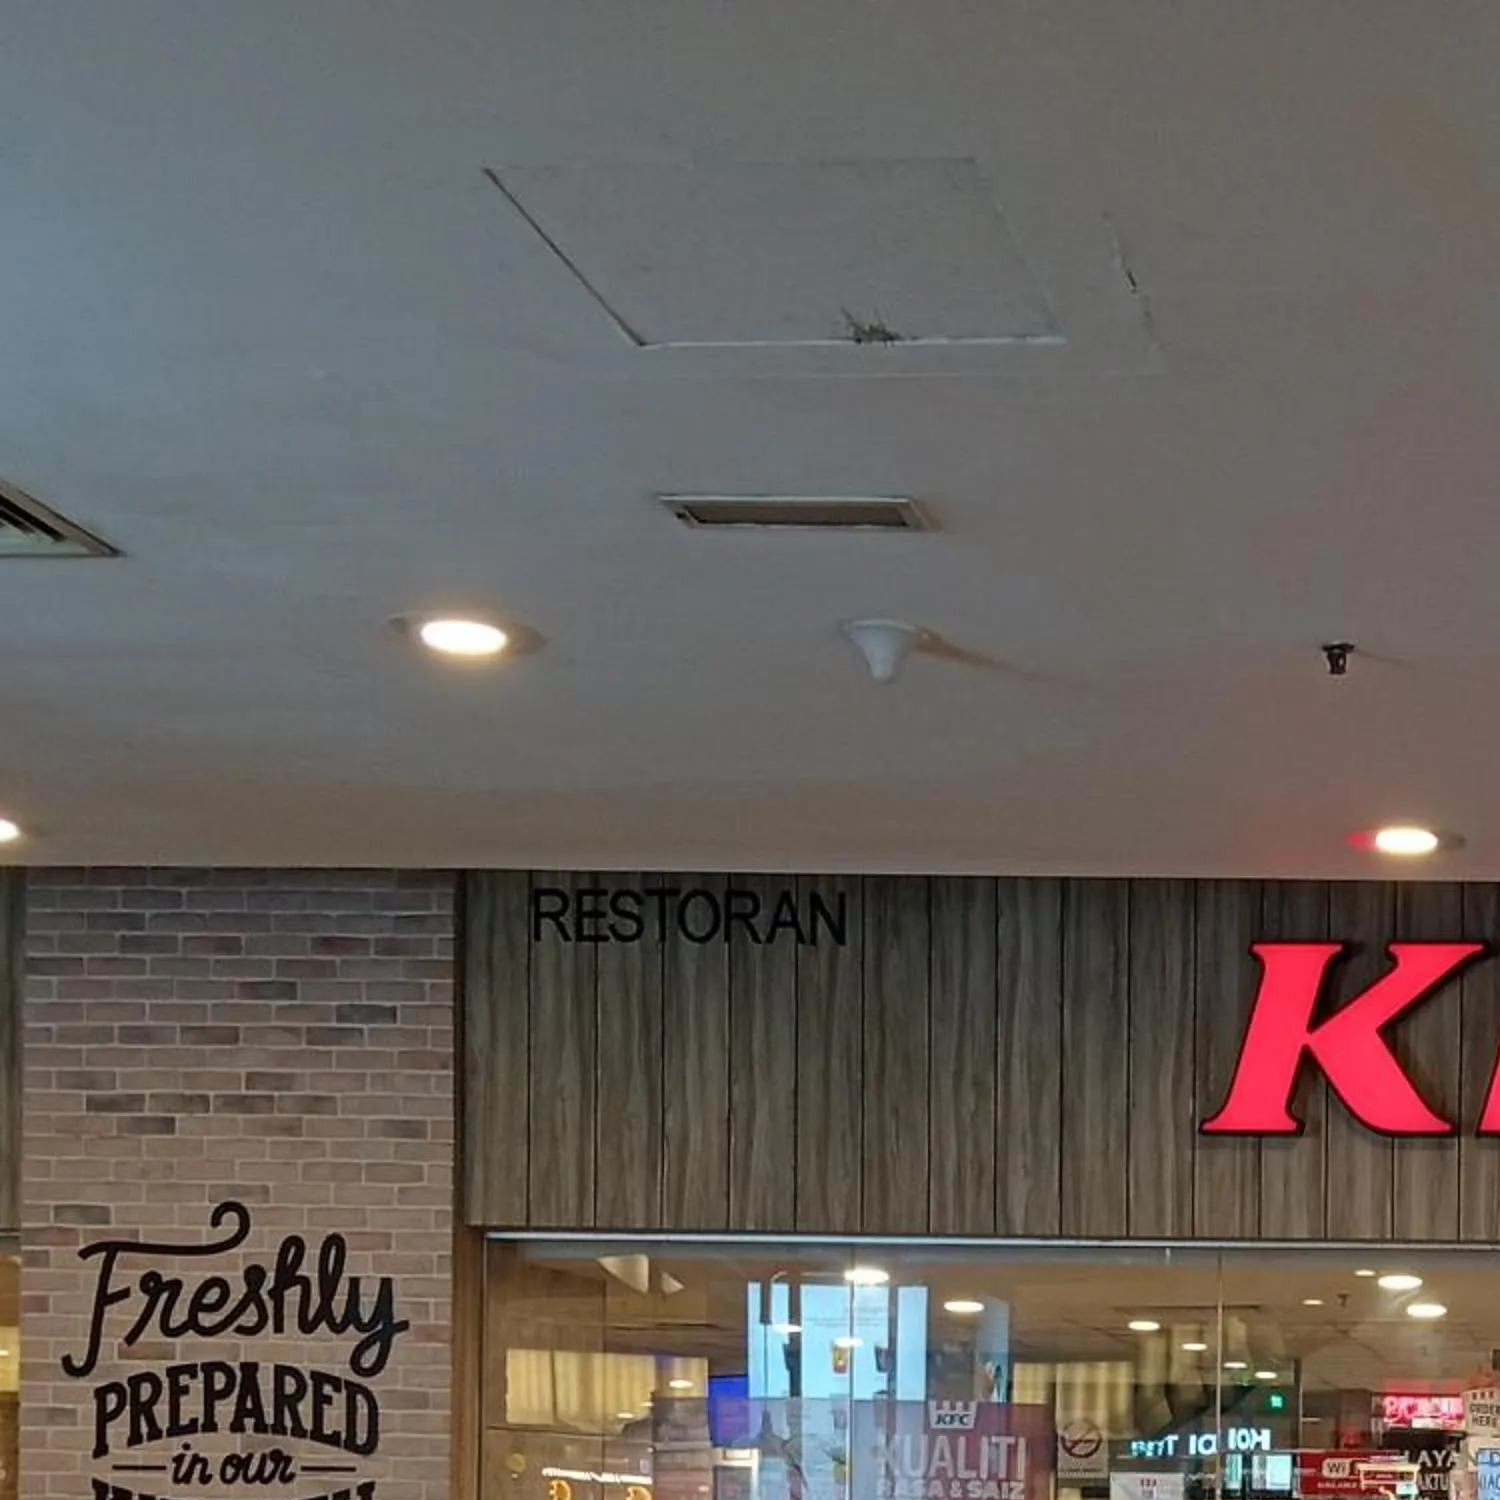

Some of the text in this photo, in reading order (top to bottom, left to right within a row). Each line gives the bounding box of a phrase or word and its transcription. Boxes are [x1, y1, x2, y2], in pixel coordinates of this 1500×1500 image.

[531, 886, 847, 948] RESTORAN
[62, 1201, 409, 1379] Freshly
[92, 1361, 380, 1460] PREPARED
[935, 1413, 970, 1426] KFC
[172, 1441, 296, 1484] in our
[876, 1434, 1027, 1479] KUALITI
[950, 1480, 963, 1498] &
[967, 1480, 1025, 1500] SAIZ
